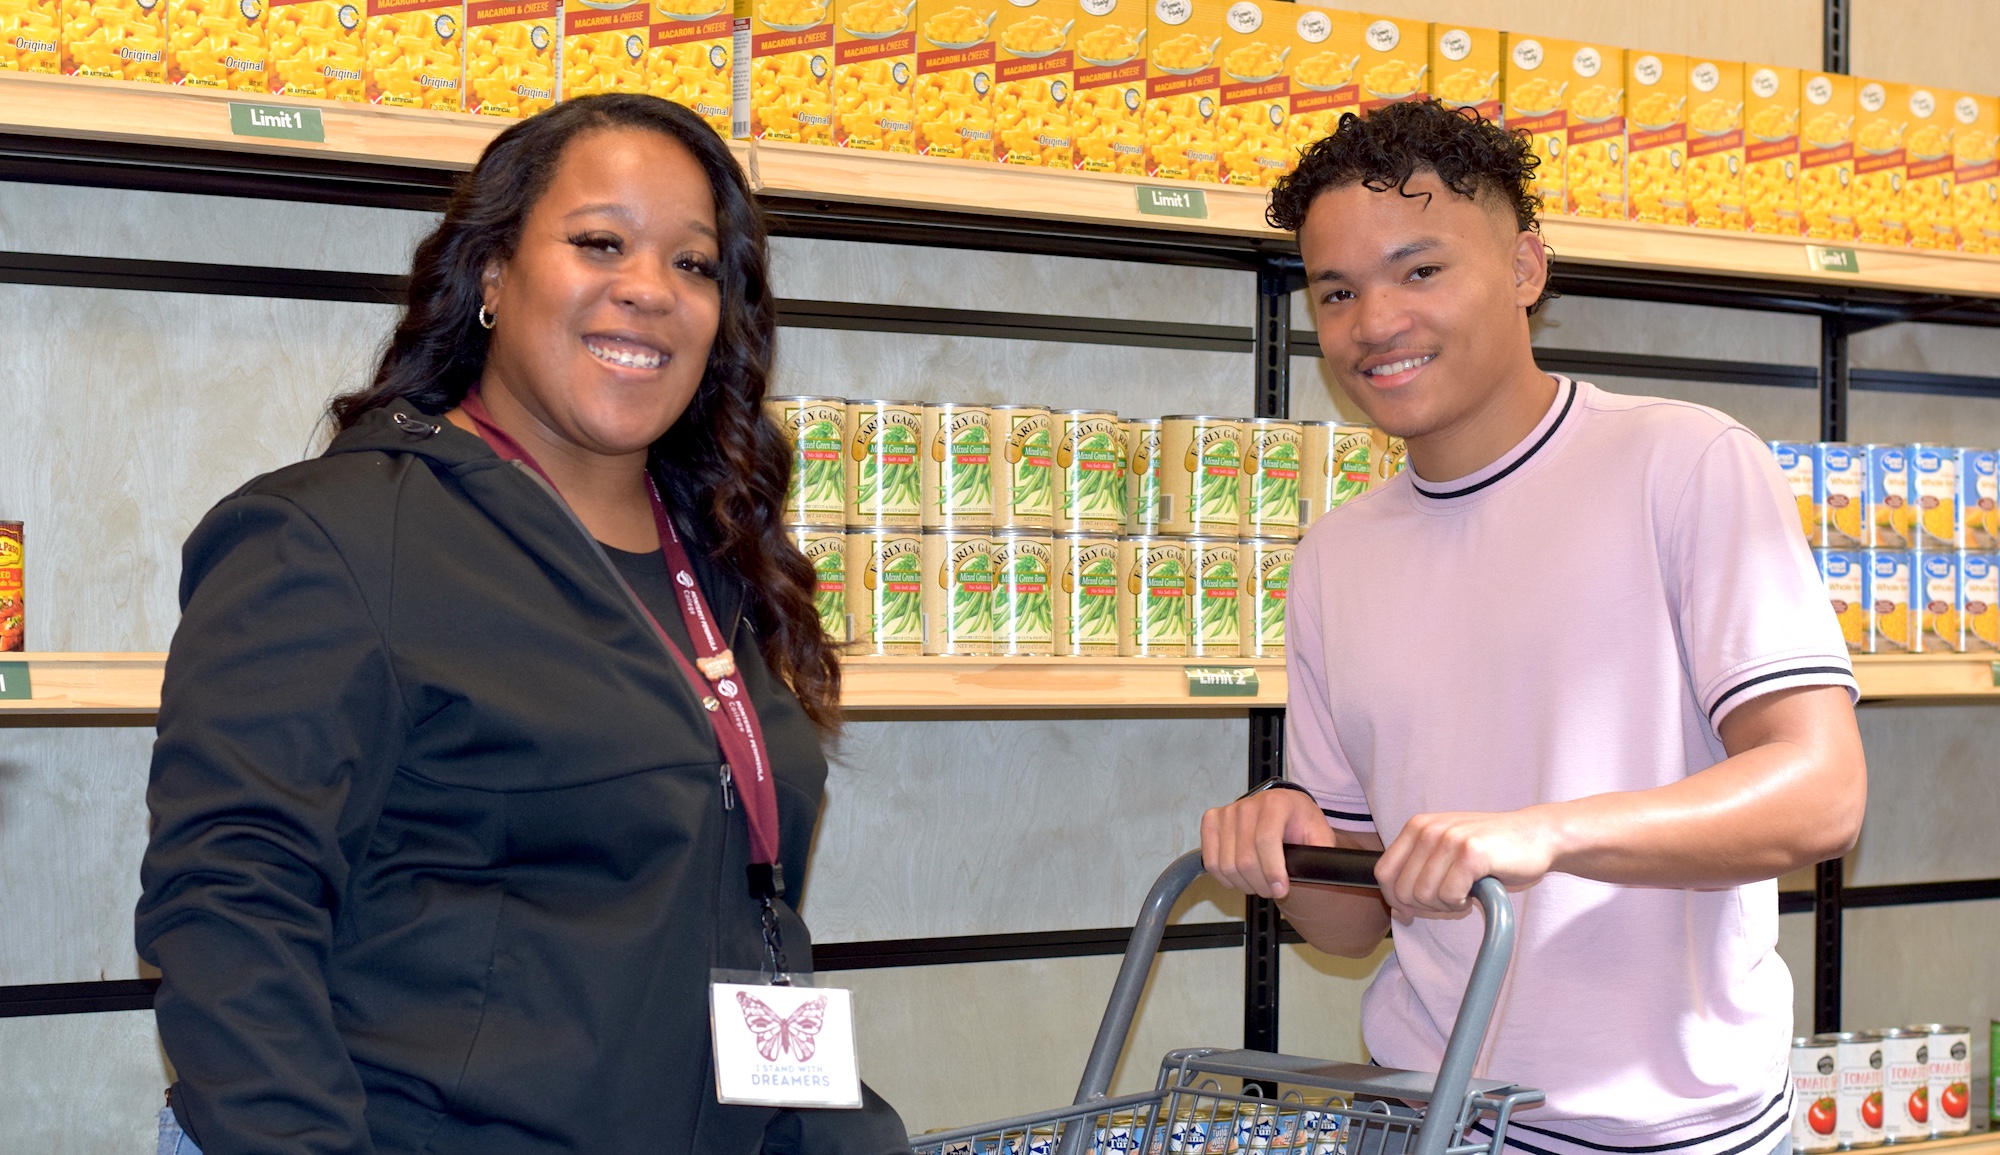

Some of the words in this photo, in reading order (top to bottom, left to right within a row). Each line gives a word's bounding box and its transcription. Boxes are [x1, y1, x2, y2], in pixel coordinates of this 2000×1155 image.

[477, 6, 515, 20] MACARONI
[517, 5, 523, 14] &
[524, 1, 549, 14] CHEESE
[574, 15, 612, 29] MACARONI
[613, 15, 619, 23] &
[620, 11, 643, 23] CHEESE
[658, 26, 695, 40] MACARONI
[696, 26, 702, 34] &
[703, 21, 727, 33] CHEESE
[15, 36, 57, 53] Original
[761, 37, 796, 50] MACARONI
[797, 36, 803, 44] &
[804, 31, 827, 44] CHEESE
[120, 47, 161, 63] Original
[844, 44, 879, 58] MACARONI
[880, 43, 885, 52] &
[886, 39, 909, 51] CHEESE
[225, 55, 264, 73] Original
[926, 54, 961, 67] MACARONI
[961, 53, 967, 61] &
[967, 48, 990, 60] CHEESE
[323, 65, 361, 81] Original
[1003, 63, 1038, 76] MACARONI
[1038, 62, 1044, 70] &
[1044, 57, 1067, 70] CHEESE
[420, 75, 458, 89] Original
[1079, 71, 1112, 84] MACARONI
[1112, 70, 1118, 78] &
[1118, 66, 1140, 78] CHEESE
[517, 85, 551, 99] Original
[696, 102, 729, 118] Original
[250, 108, 293, 129] Limit
[293, 111, 303, 129] 1
[798, 111, 829, 126] Original
[880, 118, 911, 132] Original
[961, 127, 991, 140] Original
[1039, 134, 1070, 148] Original
[1113, 142, 1142, 156] Original
[1187, 149, 1216, 163] Original
[1258, 156, 1287, 169] Original
[1151, 190, 1184, 208] Limit
[1183, 193, 1191, 208] 1
[1819, 250, 1842, 266] Limit
[1841, 252, 1848, 267] 1
[1011, 419, 1038, 448] EARLY
[815, 440, 831, 450] Green
[889, 444, 904, 454] Green
[968, 445, 983, 454] Green
[1024, 447, 1040, 456] Mixed
[1333, 438, 1358, 463] EARLY
[1077, 451, 1093, 460] Mixed
[1093, 452, 1107, 461] Green
[1204, 456, 1220, 466] Mixed
[1221, 457, 1233, 467] Green
[1263, 459, 1279, 469] Mixed
[1280, 460, 1292, 470] Green
[1343, 462, 1355, 472] Mixed
[4, 541, 19, 556] Paso
[870, 545, 901, 574] ERLY
[1068, 550, 1098, 577] ERLY
[1134, 550, 1164, 579] ERLY
[1189, 552, 1218, 580] ERLY
[884, 572, 901, 582] Mixed
[901, 573, 914, 582] Green
[959, 572, 975, 582] Mixed
[975, 573, 988, 582] Green
[1019, 573, 1034, 583] Green
[1081, 576, 1098, 586] Mixed
[1098, 577, 1111, 586] Green
[1147, 578, 1164, 587] Mixed
[1164, 579, 1177, 587] Green
[1203, 580, 1218, 588] Mixed
[1218, 580, 1231, 589] Green
[1266, 580, 1281, 589] Mixed
[683, 589, 696, 615] College
[1200, 669, 1232, 685] Limit
[1232, 669, 1247, 686] 2
[728, 701, 745, 733] College
[763, 1065, 795, 1073] STAND
[797, 1065, 823, 1073] WITH
[751, 1073, 831, 1087] DREAMERS
